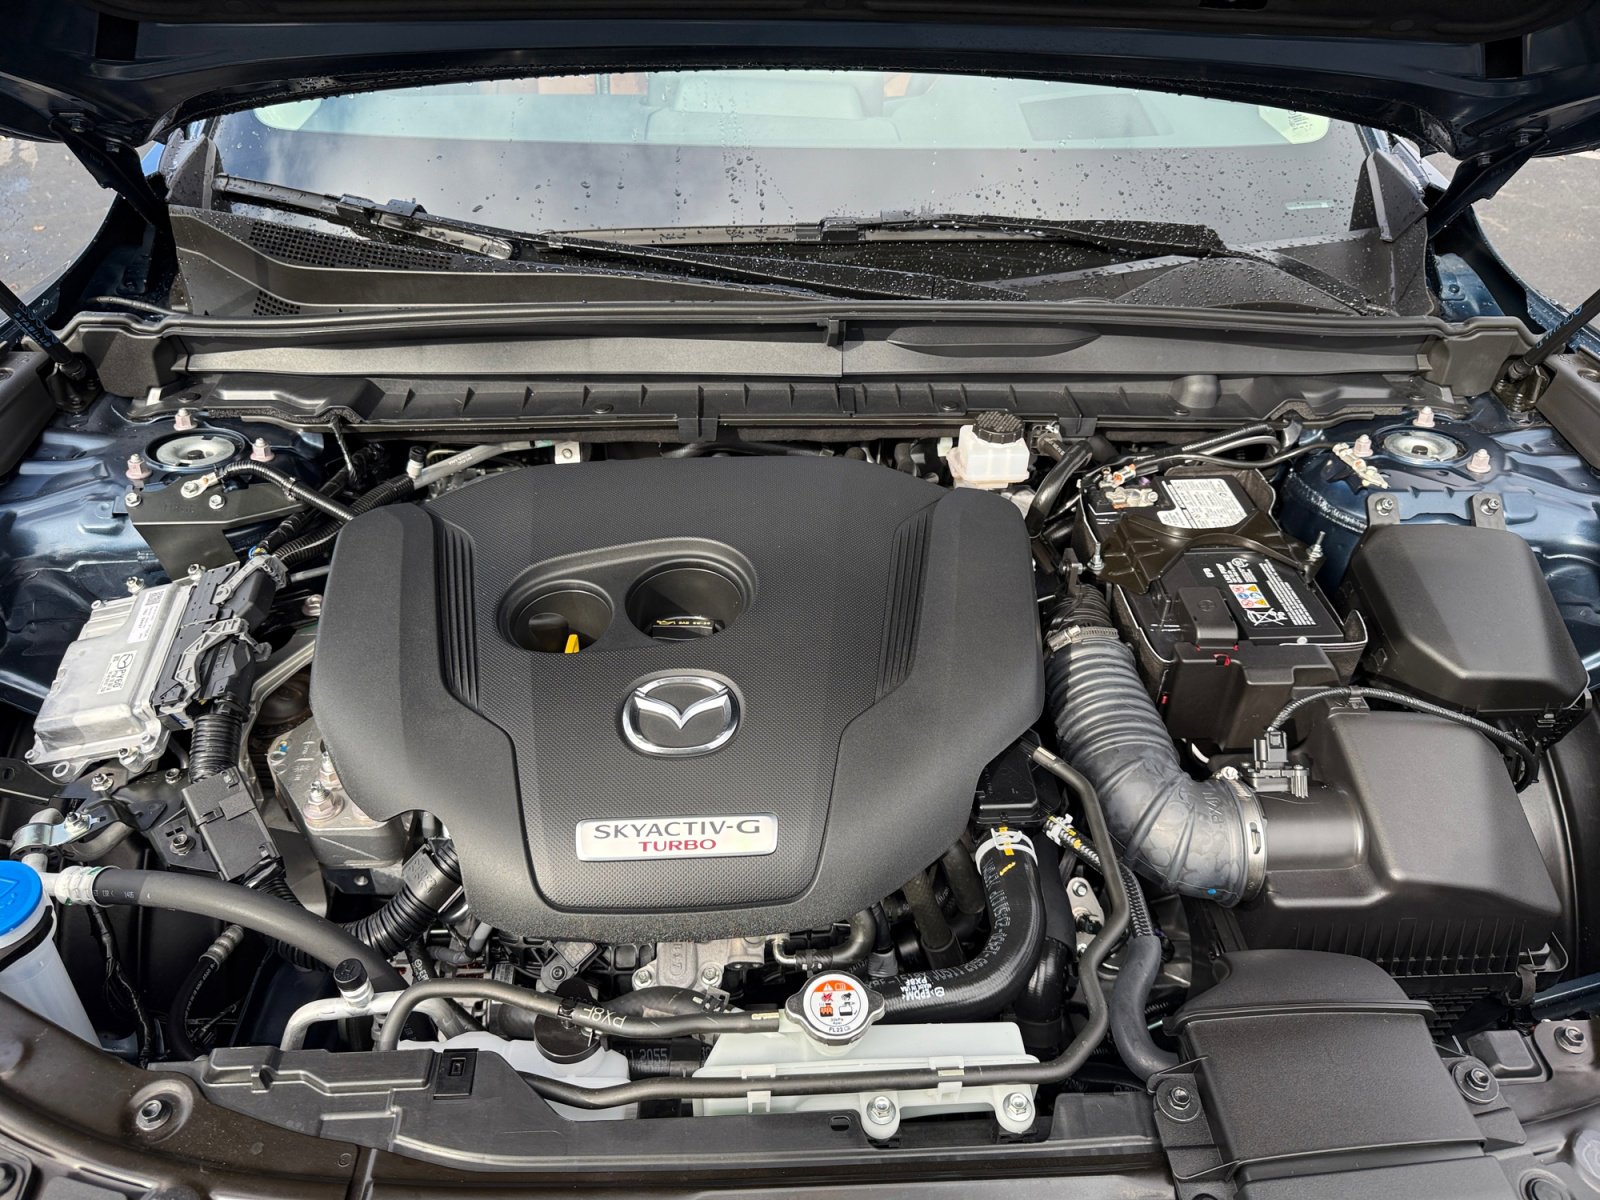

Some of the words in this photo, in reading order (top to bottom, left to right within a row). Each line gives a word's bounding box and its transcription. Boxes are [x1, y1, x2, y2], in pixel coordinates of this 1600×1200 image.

[593, 819, 760, 839] SKYACTIV-G
[638, 838, 717, 852] TURBO
[580, 1006, 627, 1029] PX8F
